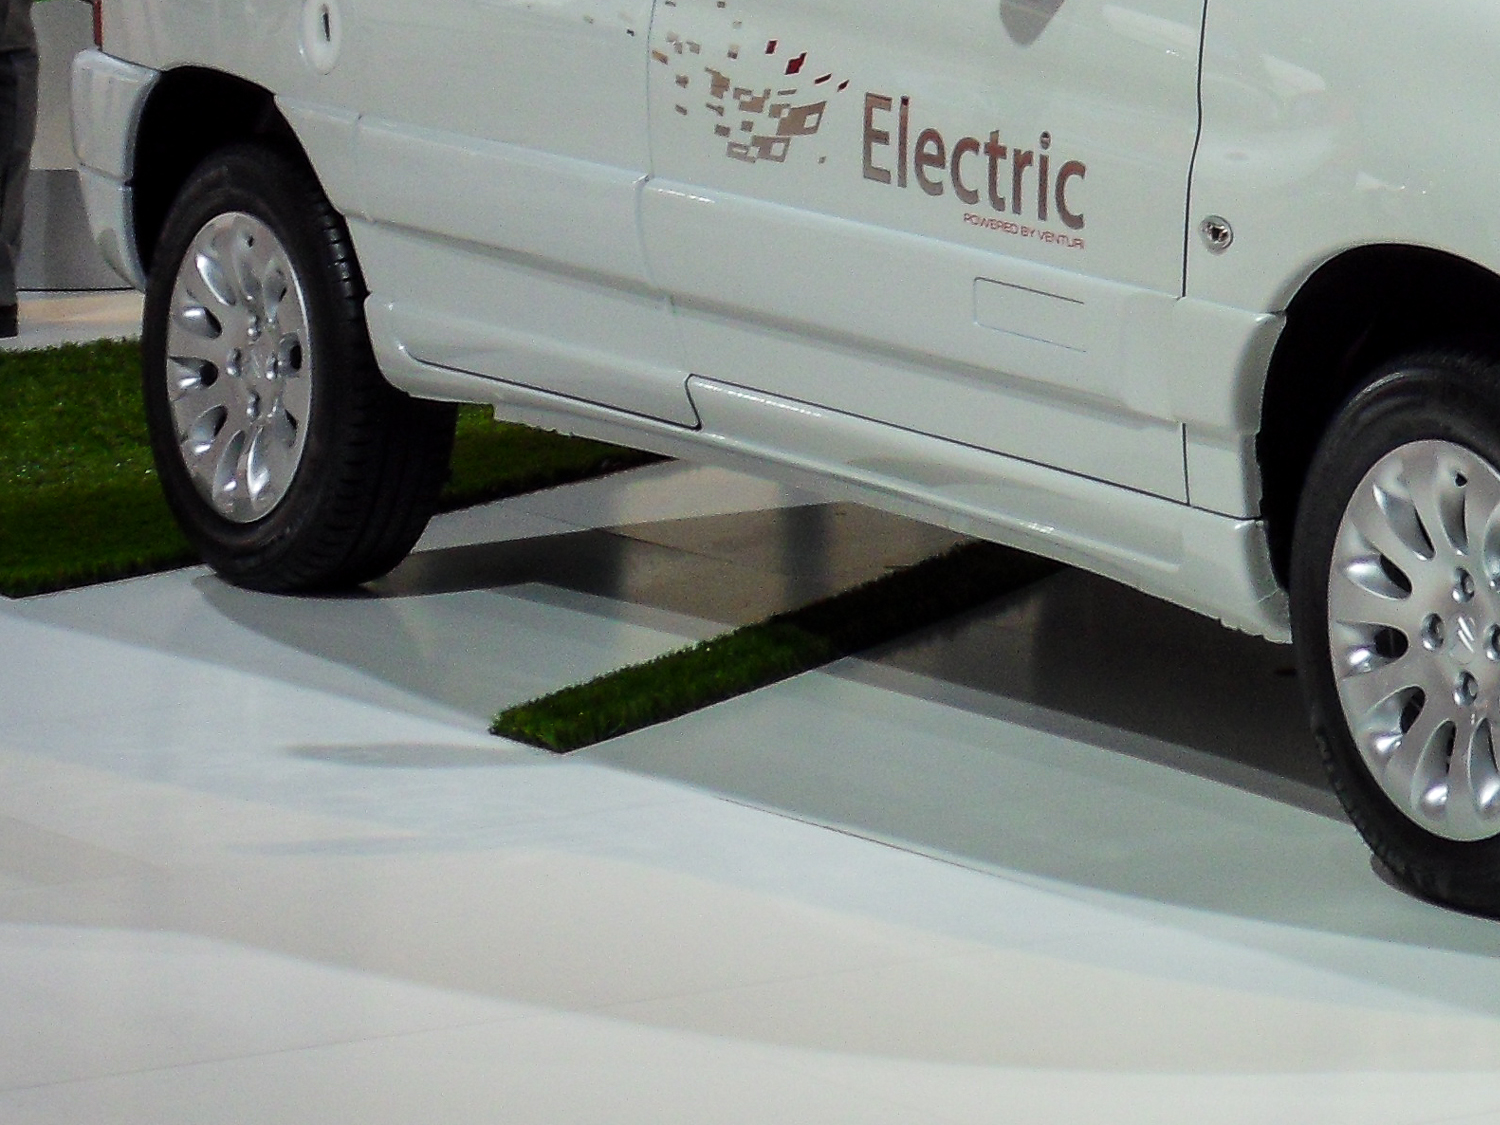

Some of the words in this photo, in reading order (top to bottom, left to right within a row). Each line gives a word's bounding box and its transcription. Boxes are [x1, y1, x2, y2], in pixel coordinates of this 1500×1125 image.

[862, 91, 1087, 231] Electric
[963, 212, 1019, 235] POWERED
[1020, 225, 1036, 238] BY
